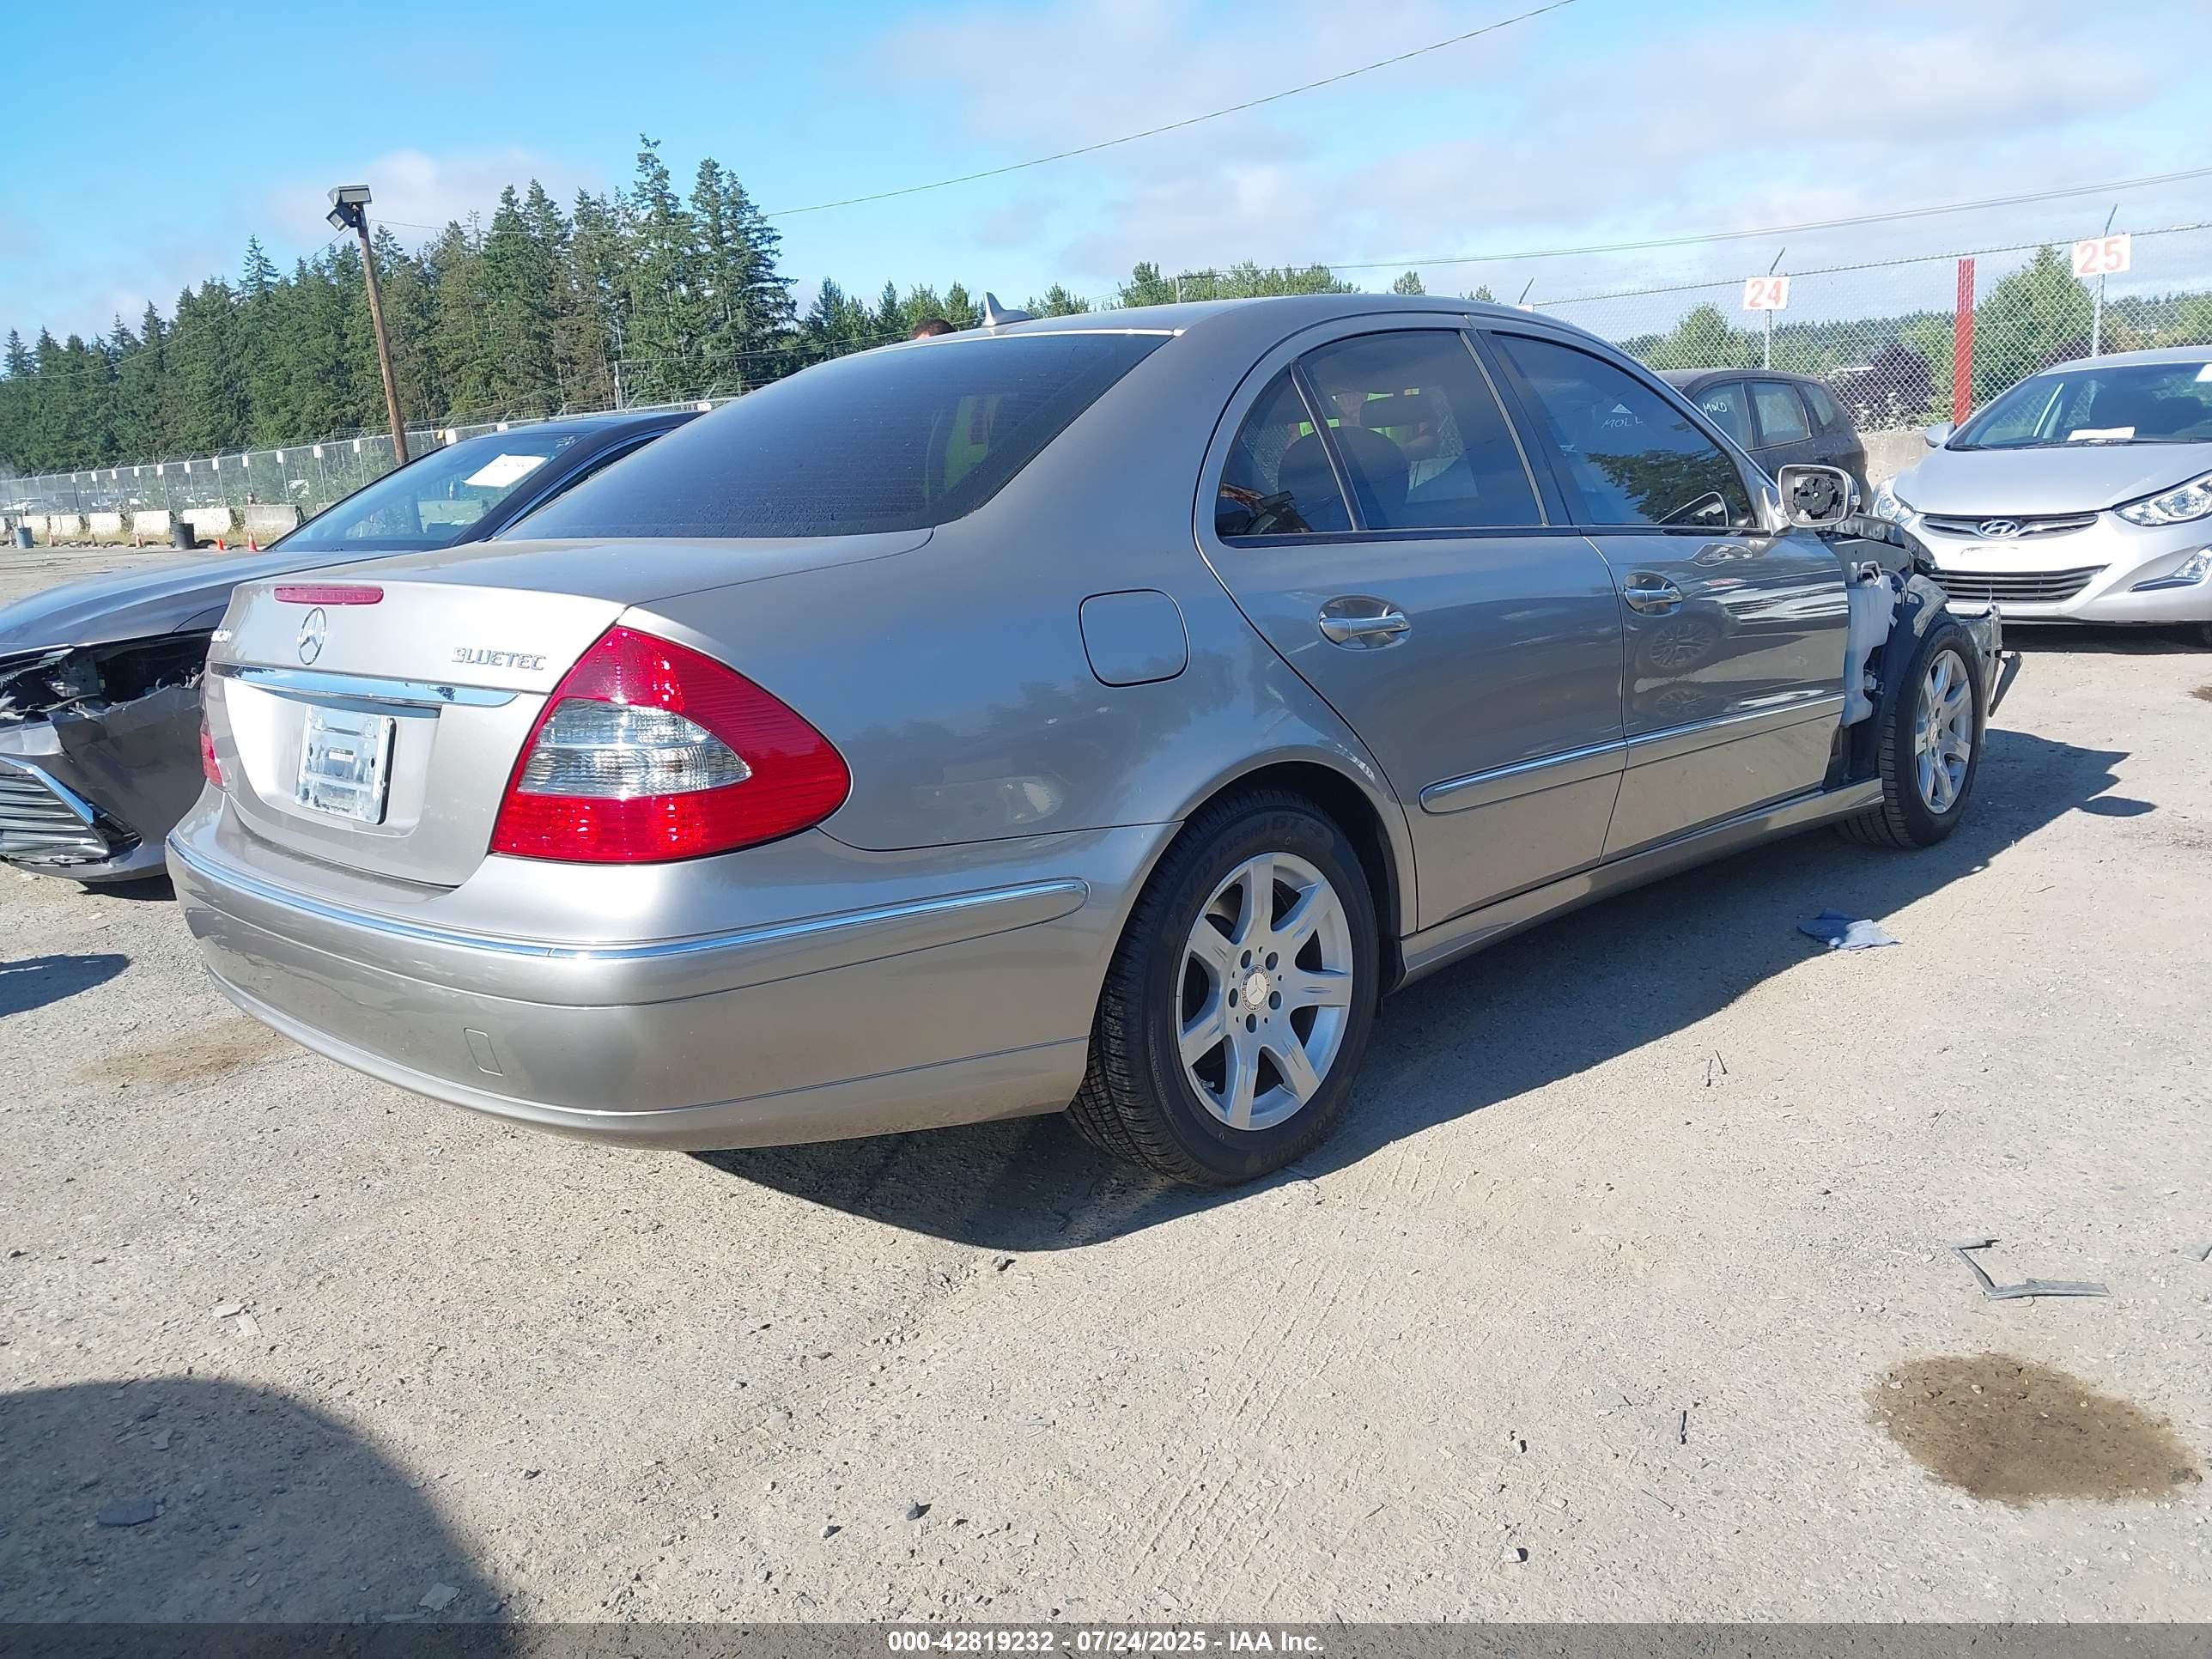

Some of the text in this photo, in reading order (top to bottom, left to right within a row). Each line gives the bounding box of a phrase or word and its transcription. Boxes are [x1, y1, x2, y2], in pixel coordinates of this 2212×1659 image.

[2079, 240, 2124, 274] 25
[1748, 280, 1783, 307] 24
[452, 647, 547, 671] BLUETEC
